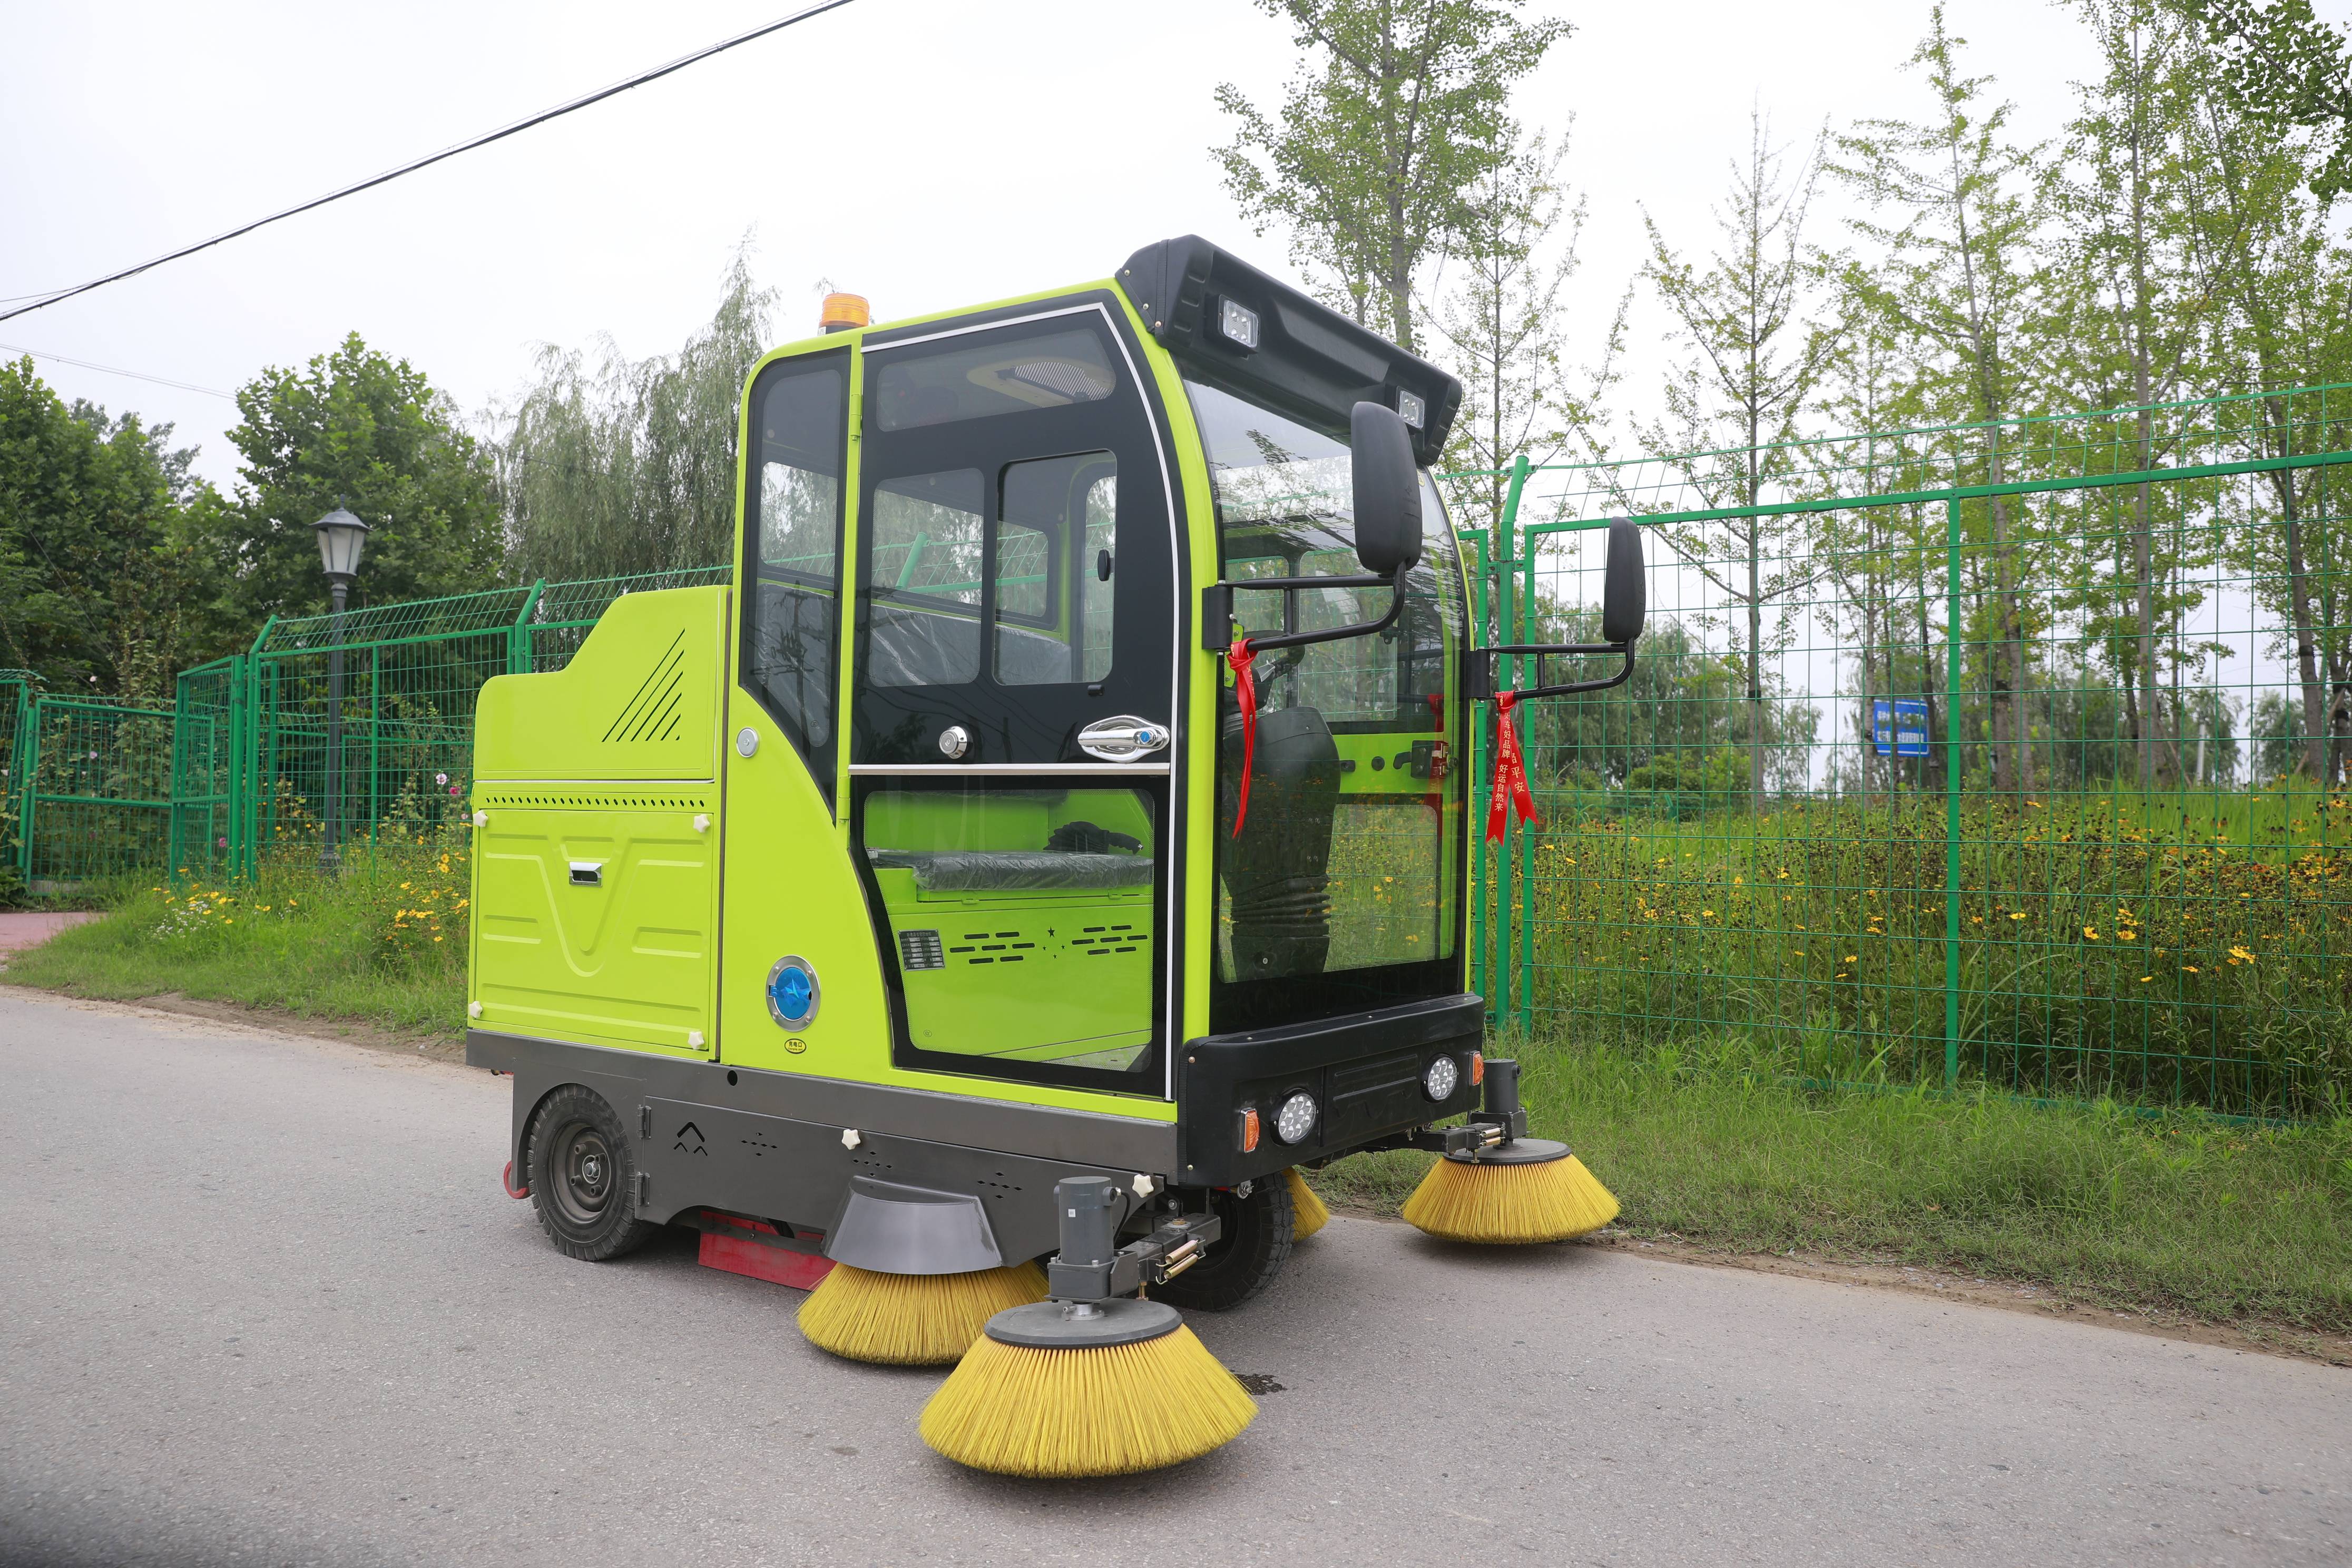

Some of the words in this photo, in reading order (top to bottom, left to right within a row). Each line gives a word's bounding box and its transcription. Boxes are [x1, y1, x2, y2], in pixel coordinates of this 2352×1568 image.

[1501, 712, 1511, 758] 好车好品牌
[1494, 764, 1508, 811] 好运自然来
